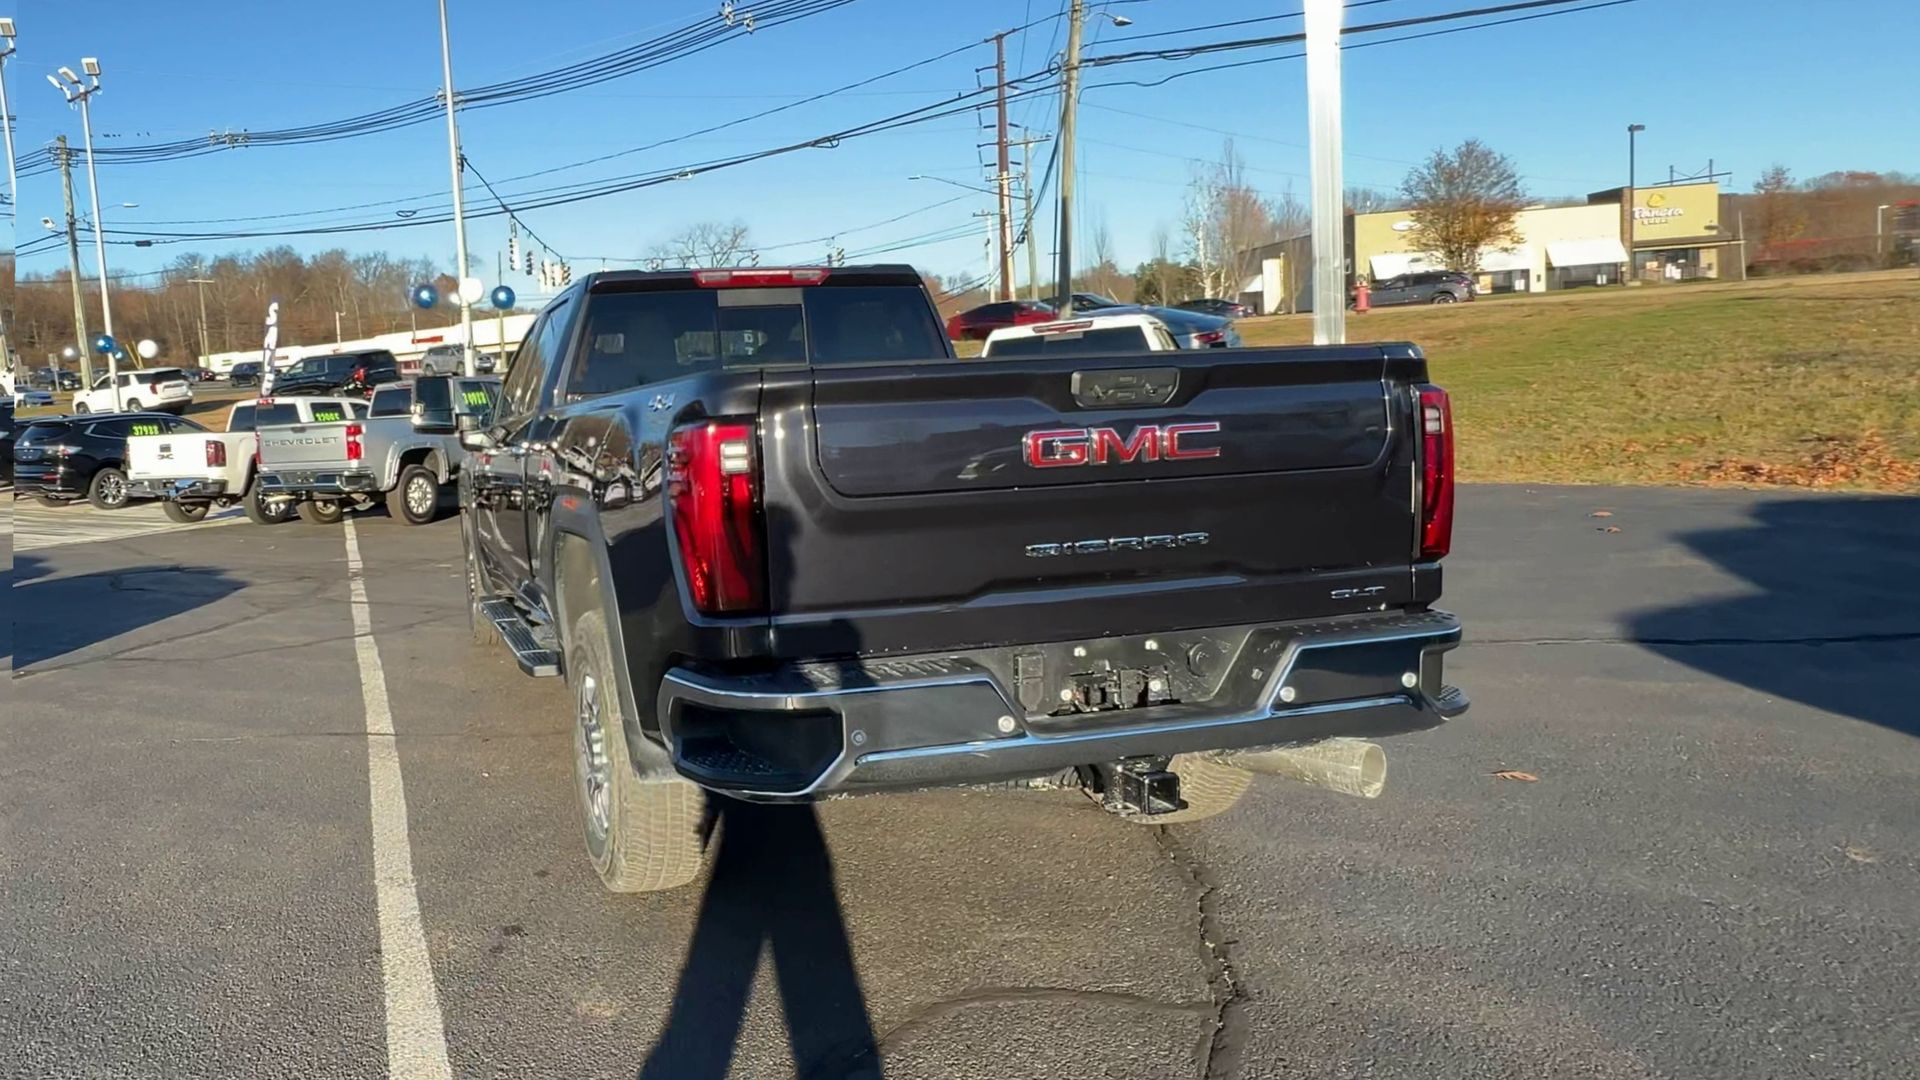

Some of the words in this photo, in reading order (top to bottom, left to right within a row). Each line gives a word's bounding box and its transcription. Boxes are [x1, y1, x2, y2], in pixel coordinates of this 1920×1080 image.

[264, 436, 338, 447] CHEVROLET
[1022, 421, 1221, 468] GMC
[1025, 532, 1209, 557] SIERRA
[1331, 586, 1386, 599] SLT
